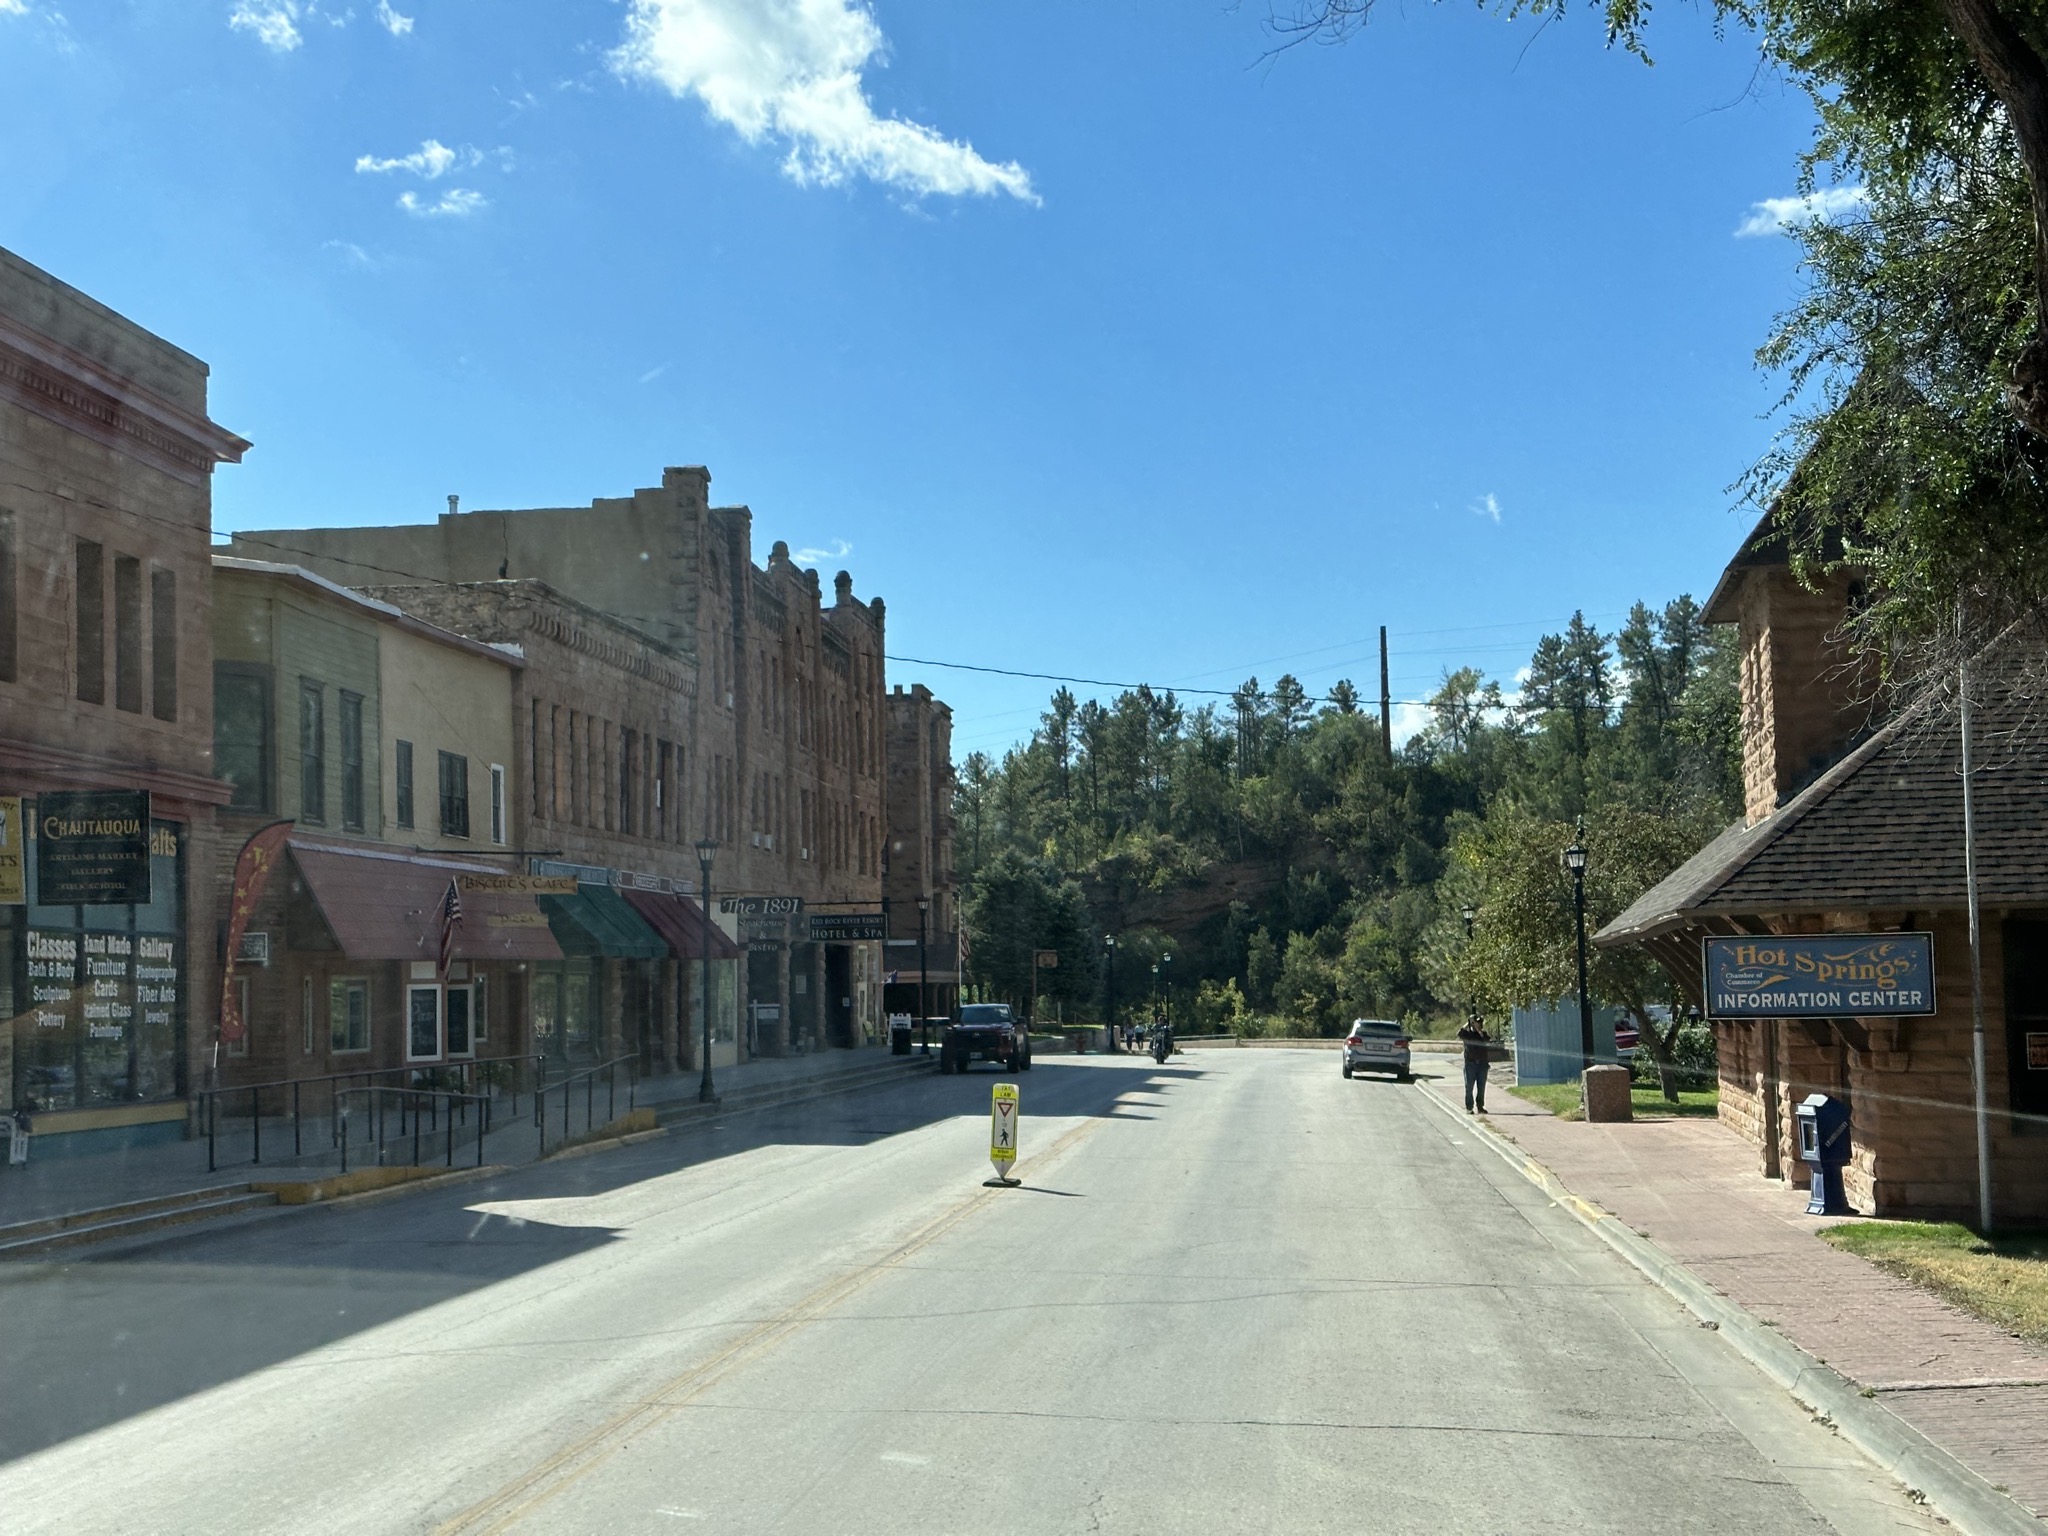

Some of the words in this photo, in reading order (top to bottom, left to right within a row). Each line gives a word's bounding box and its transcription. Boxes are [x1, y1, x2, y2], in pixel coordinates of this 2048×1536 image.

[44, 816, 141, 840] CHAUTAUQUA
[722, 898, 756, 914] The
[763, 898, 800, 914] 1891
[811, 929, 847, 939] HOTEL
[852, 928, 860, 938] &
[864, 927, 883, 938] SPA
[27, 931, 77, 960] Classes
[108, 935, 131, 955] Made
[140, 937, 173, 963] Gallery
[28, 961, 47, 977] Bath
[48, 964, 54, 977] &
[55, 962, 75, 981] Body
[86, 957, 127, 976] Furniture
[136, 965, 177, 982] Photography
[1736, 945, 1790, 966] Hot
[1794, 950, 1910, 990] Springs
[33, 985, 71, 1004] Sculpture
[94, 979, 119, 997] Cards
[137, 986, 158, 1003] Fiber
[160, 986, 176, 1002] Arts
[1718, 992, 1841, 1009] INFORMATION
[1848, 990, 1922, 1007] CENTER
[111, 1002, 132, 1017] Glass
[144, 1009, 169, 1026] Jewelry
[38, 1011, 66, 1030] Pottery
[89, 1023, 123, 1041] Paintings
